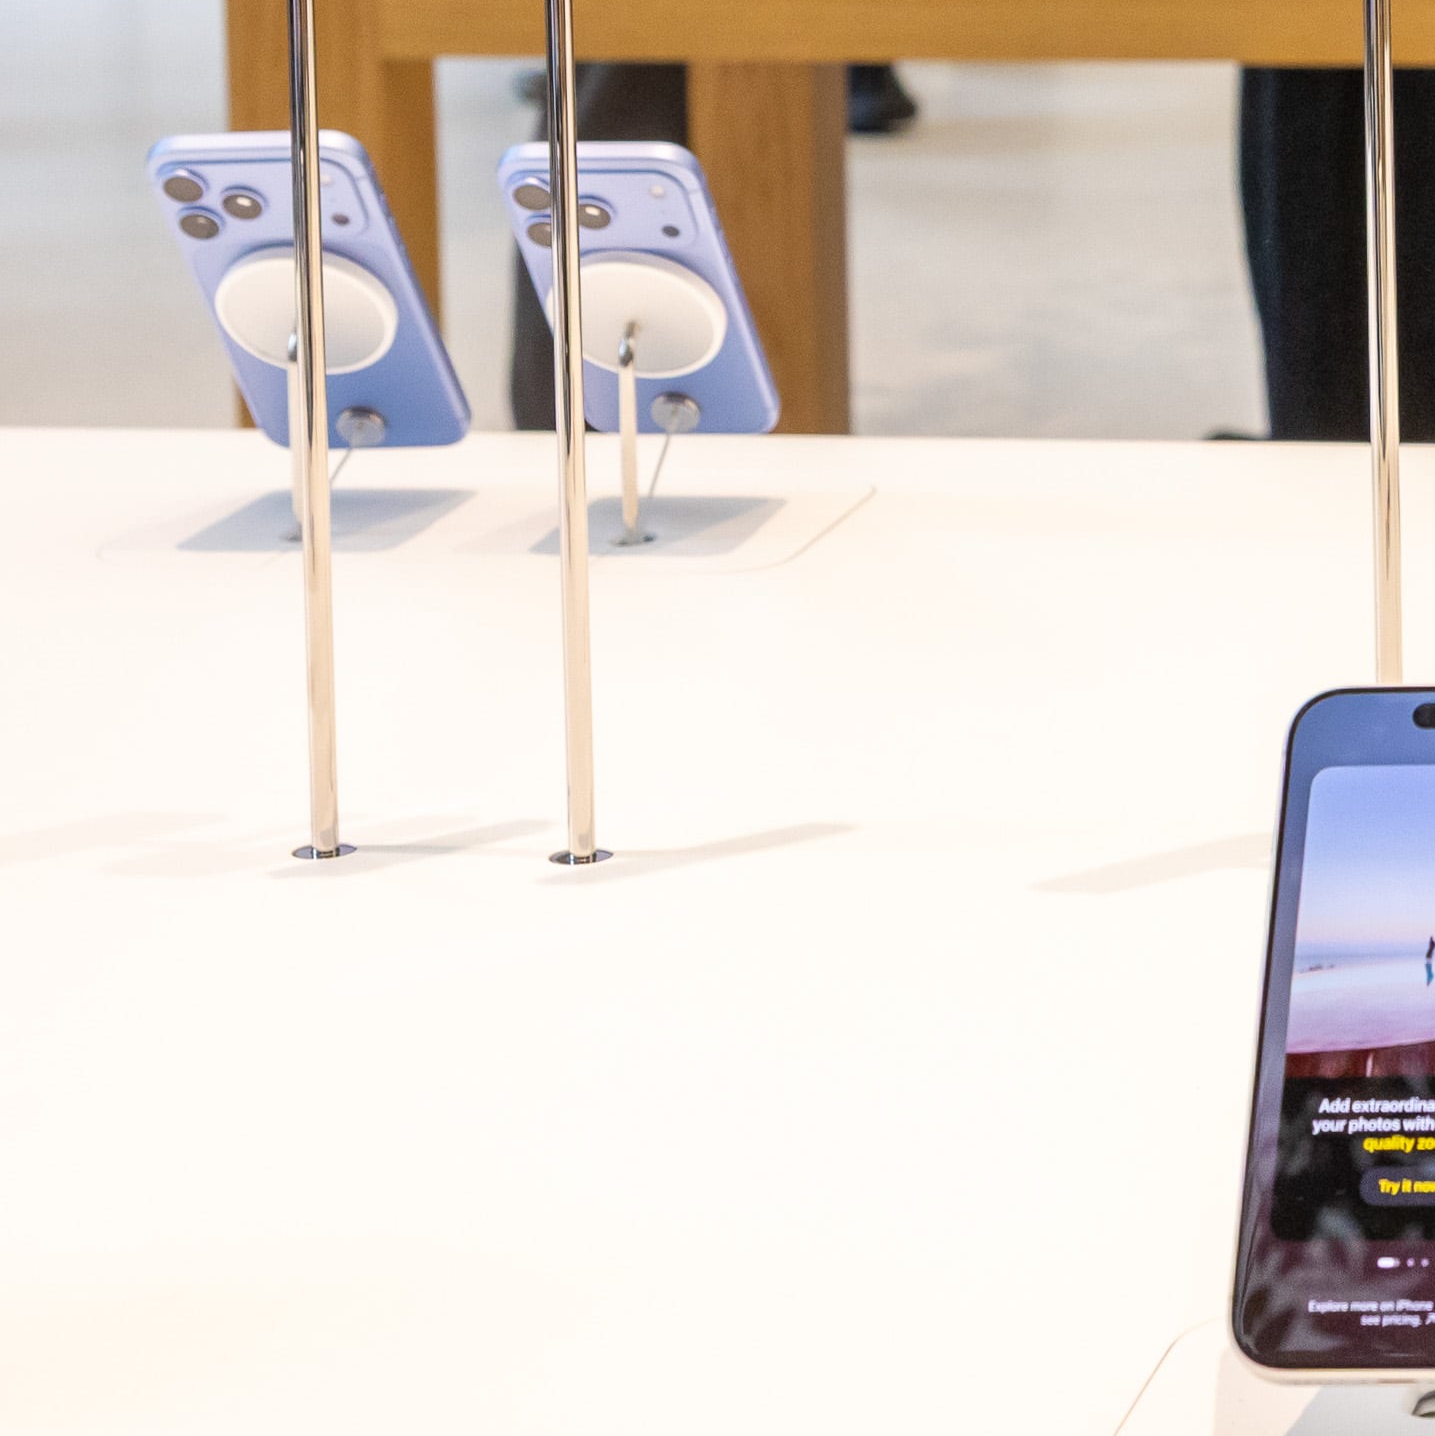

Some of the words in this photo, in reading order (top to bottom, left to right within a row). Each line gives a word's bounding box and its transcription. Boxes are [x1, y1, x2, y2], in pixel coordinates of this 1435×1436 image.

[1318, 1097, 1351, 1113] Add
[1311, 1119, 1347, 1135] your
[1347, 1117, 1401, 1134] photos
[1402, 1116, 1435, 1131] with
[1362, 1134, 1415, 1153] quality
[1378, 1178, 1400, 1196] Try
[1401, 1178, 1412, 1193] it
[1308, 1299, 1349, 1314] Explore
[1350, 1300, 1379, 1312] more
[1395, 1299, 1434, 1312] iPhone
[1360, 1314, 1381, 1326] see
